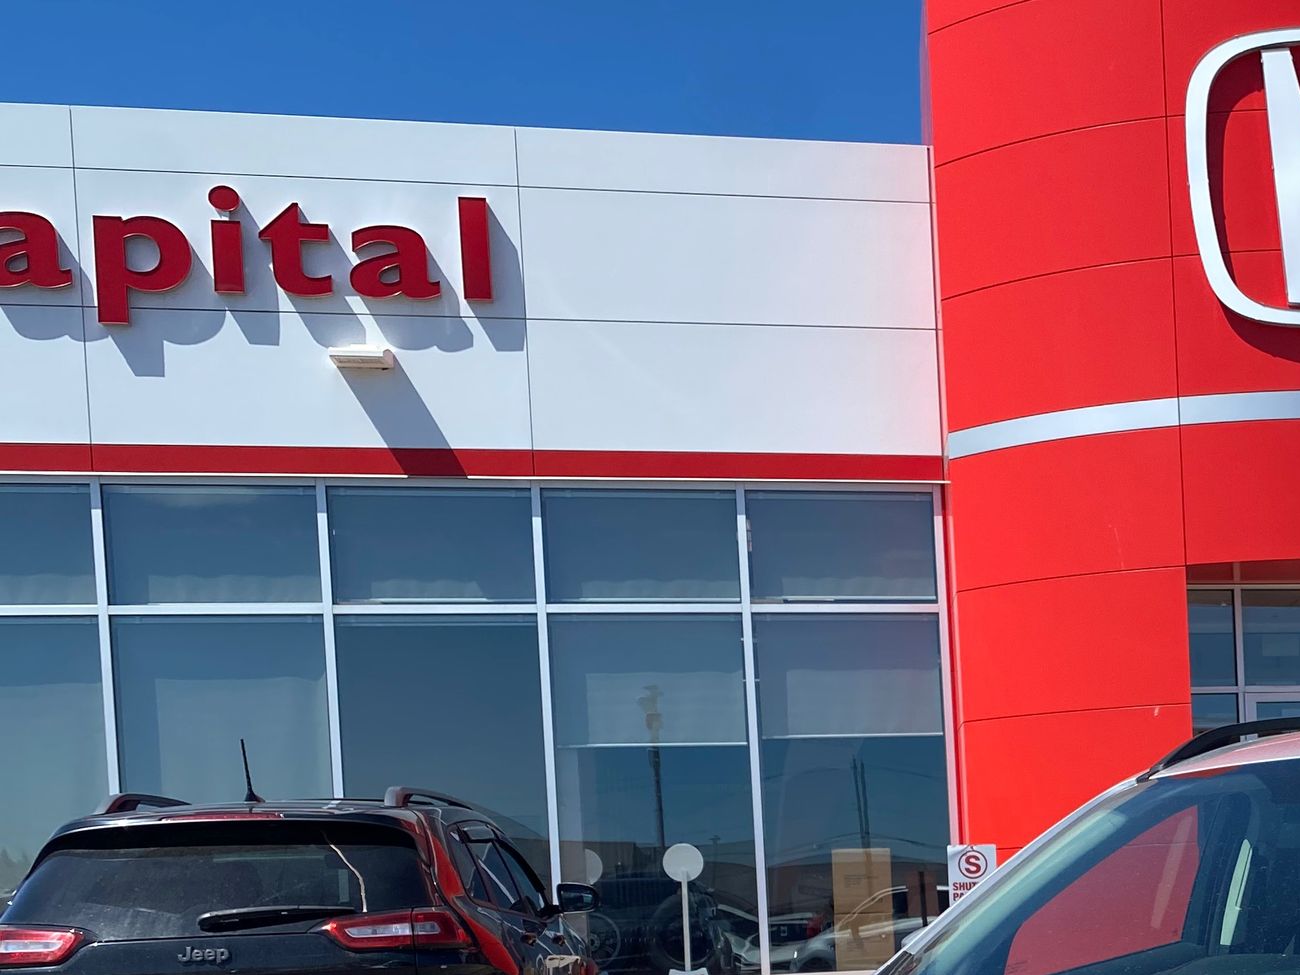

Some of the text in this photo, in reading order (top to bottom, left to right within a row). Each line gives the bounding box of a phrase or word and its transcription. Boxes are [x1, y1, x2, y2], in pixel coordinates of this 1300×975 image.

[964, 854, 982, 874] S
[953, 881, 979, 891] SHUT
[177, 946, 230, 964] Jeep
